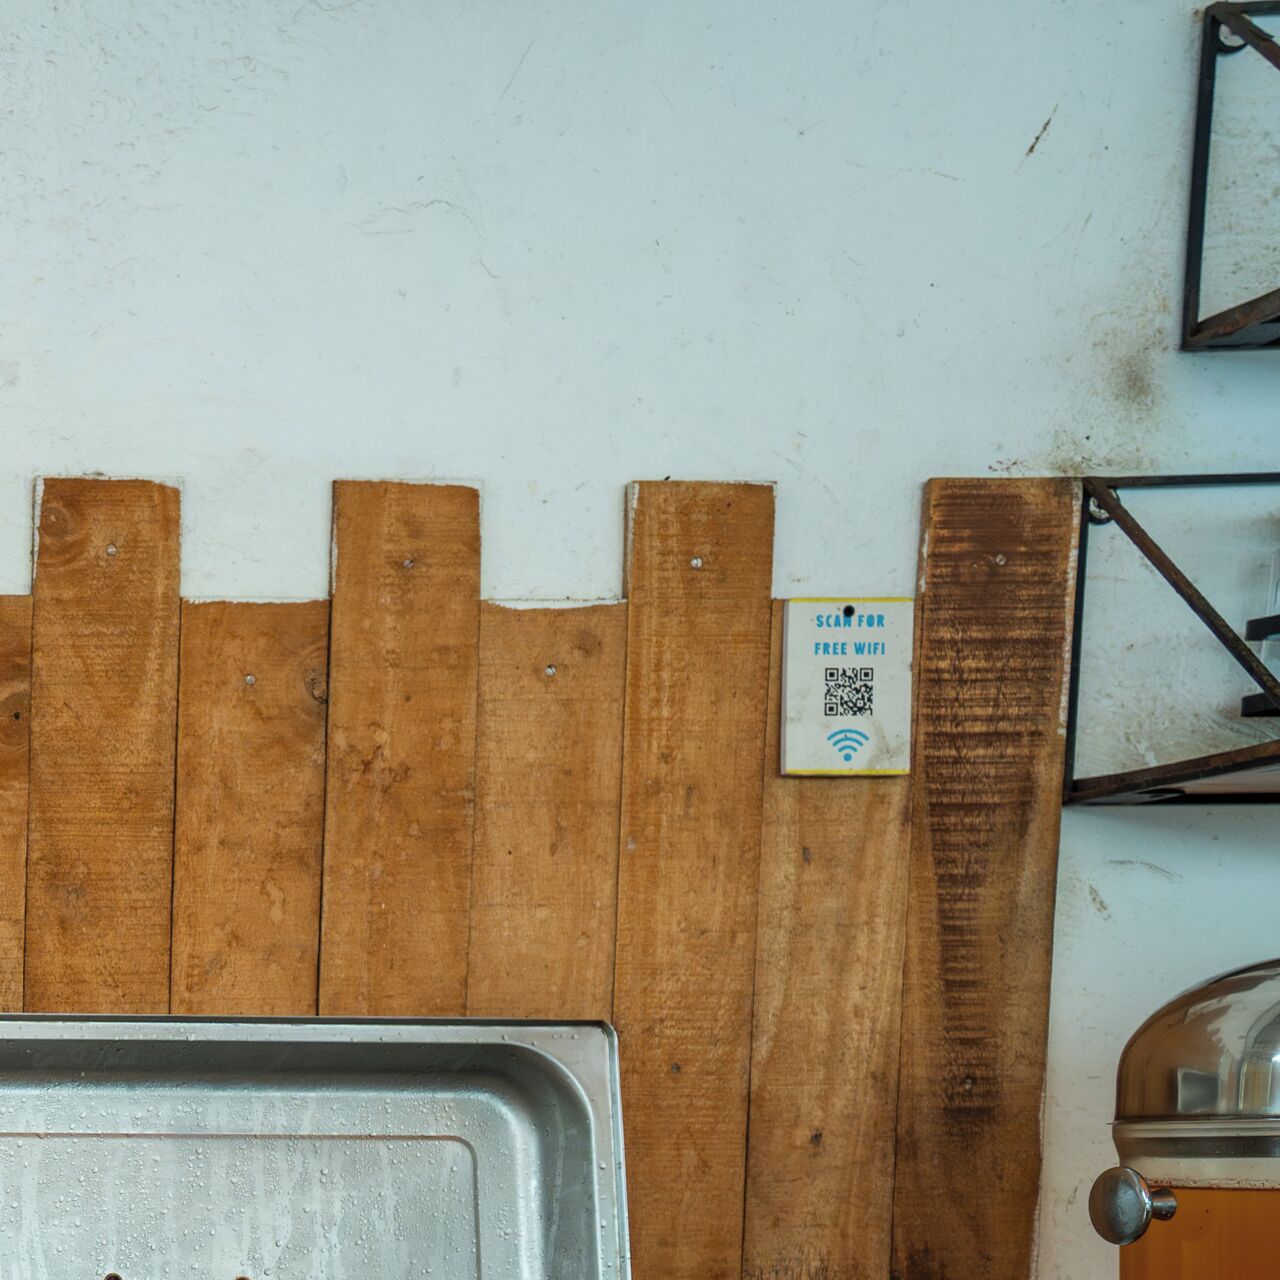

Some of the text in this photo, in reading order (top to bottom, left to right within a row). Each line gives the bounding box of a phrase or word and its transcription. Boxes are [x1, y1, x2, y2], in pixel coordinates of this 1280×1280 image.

[816, 614, 885, 628] SCAN FOR
[814, 642, 885, 655] FREE WIFI
